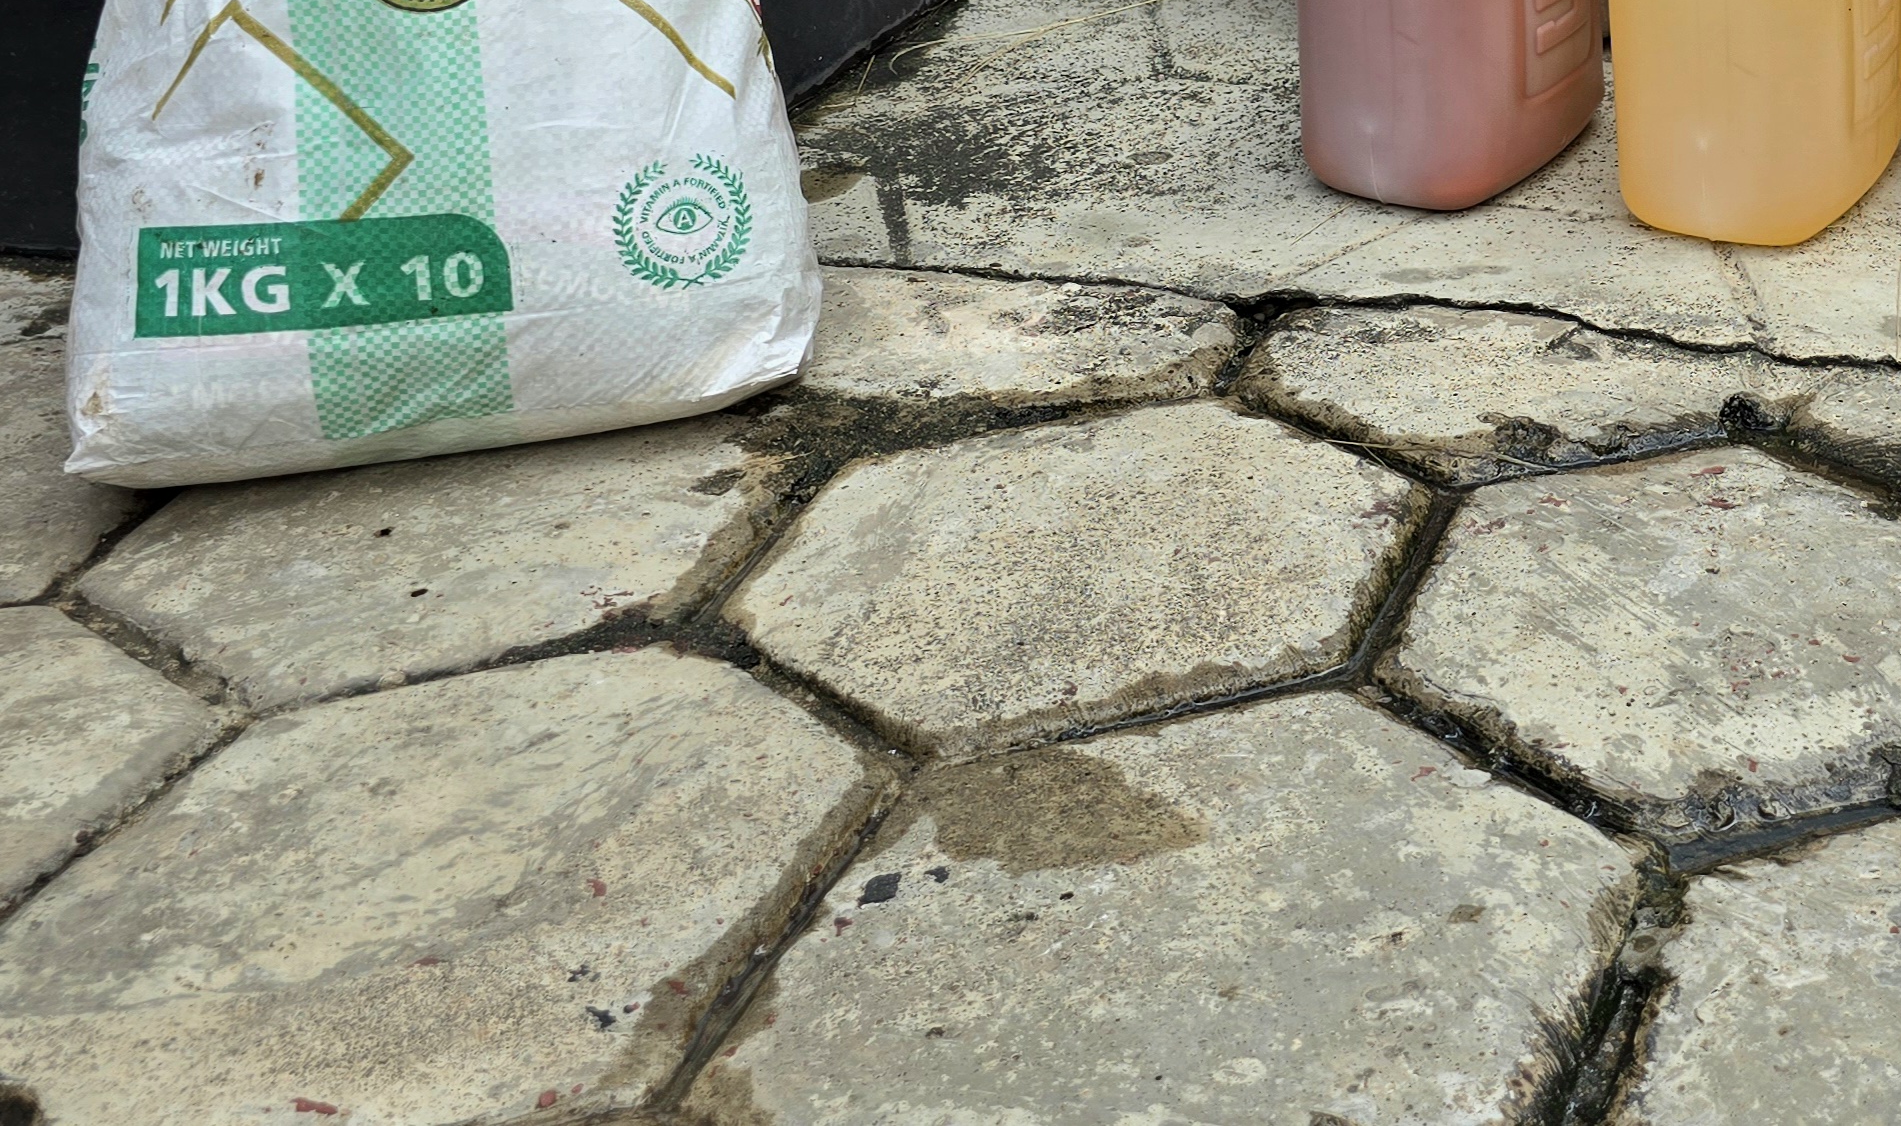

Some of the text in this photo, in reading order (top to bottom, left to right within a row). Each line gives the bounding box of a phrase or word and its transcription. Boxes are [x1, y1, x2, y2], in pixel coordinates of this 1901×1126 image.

[640, 177, 726, 223] VITAMIN A FORTIFIED
[677, 210, 694, 228] A
[160, 236, 282, 260] NET WEIGHT
[642, 231, 685, 264] FORTIFIED
[154, 264, 291, 318] 1KG
[320, 262, 371, 310] X
[399, 249, 486, 303] 10
